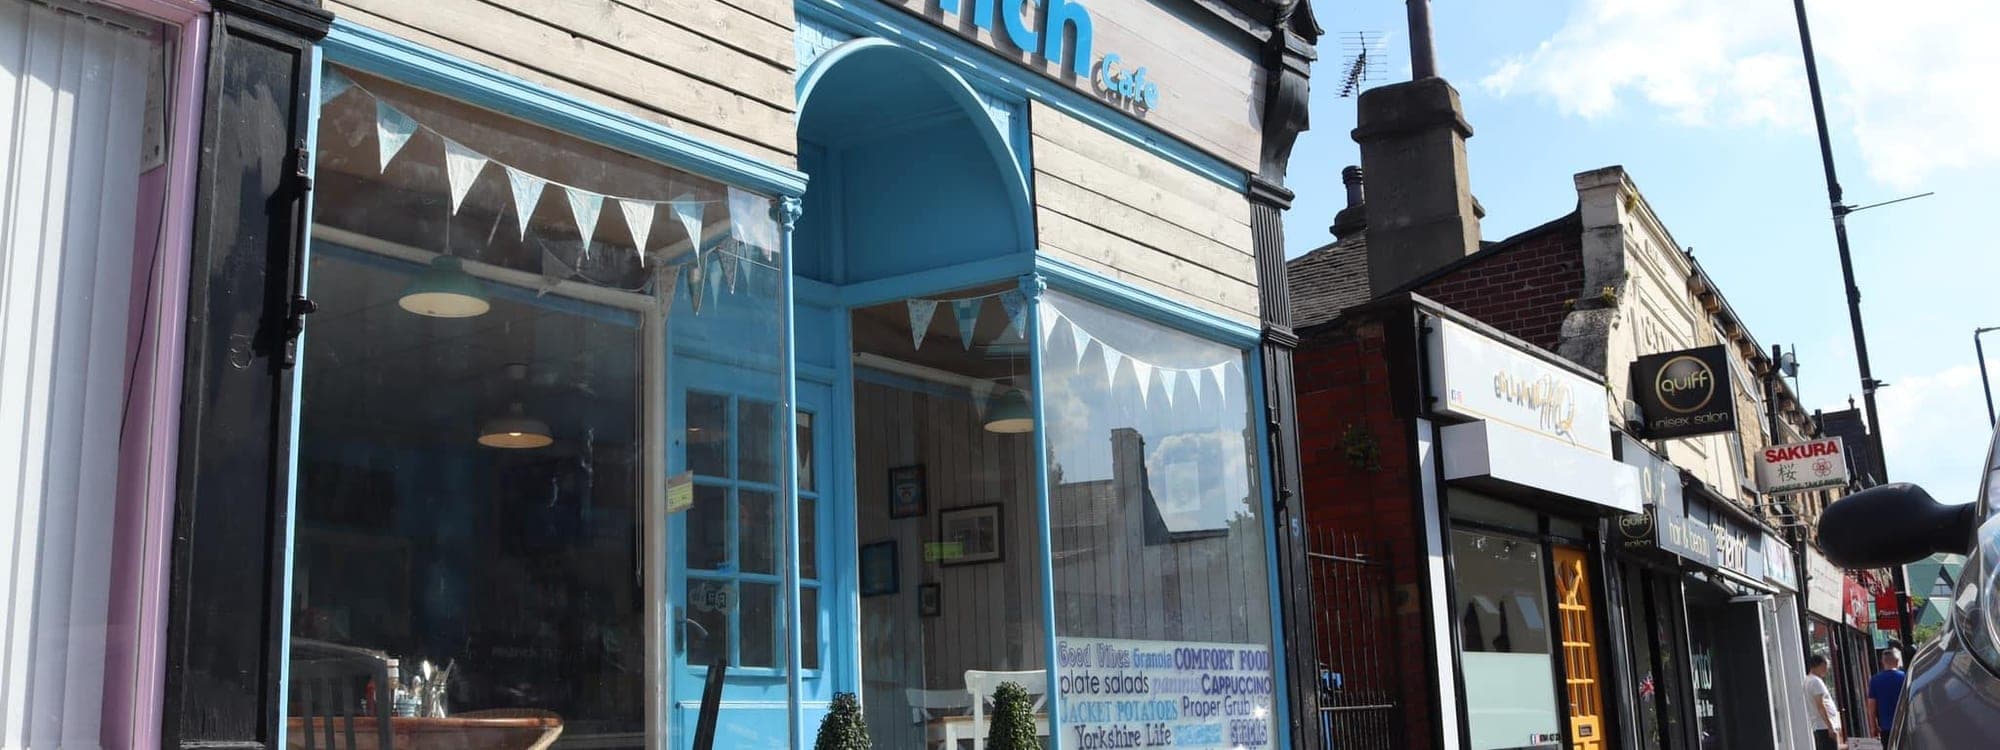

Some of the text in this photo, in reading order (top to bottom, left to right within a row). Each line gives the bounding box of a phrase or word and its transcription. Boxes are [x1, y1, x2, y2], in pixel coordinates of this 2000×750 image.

[1103, 53, 1160, 111] Cafe
[1661, 370, 1708, 396] quiff
[1650, 411, 1729, 430] unisex salon
[1765, 440, 1839, 464] SAKURA
[1058, 641, 1092, 668] Good
[1133, 647, 1174, 669] Granola
[1174, 647, 1236, 670] COMFORT
[1240, 650, 1271, 670] FOOD
[1060, 669, 1100, 698] plate
[1104, 669, 1149, 694] salads
[1201, 673, 1273, 696] CAPPUCCINO
[1061, 698, 1114, 724] JACKET
[1117, 699, 1178, 722] POTATOES
[1182, 695, 1221, 722] Proper
[1224, 695, 1251, 717] Grub
[1074, 723, 1142, 750] Yorkshire
[1146, 721, 1172, 746] Life
